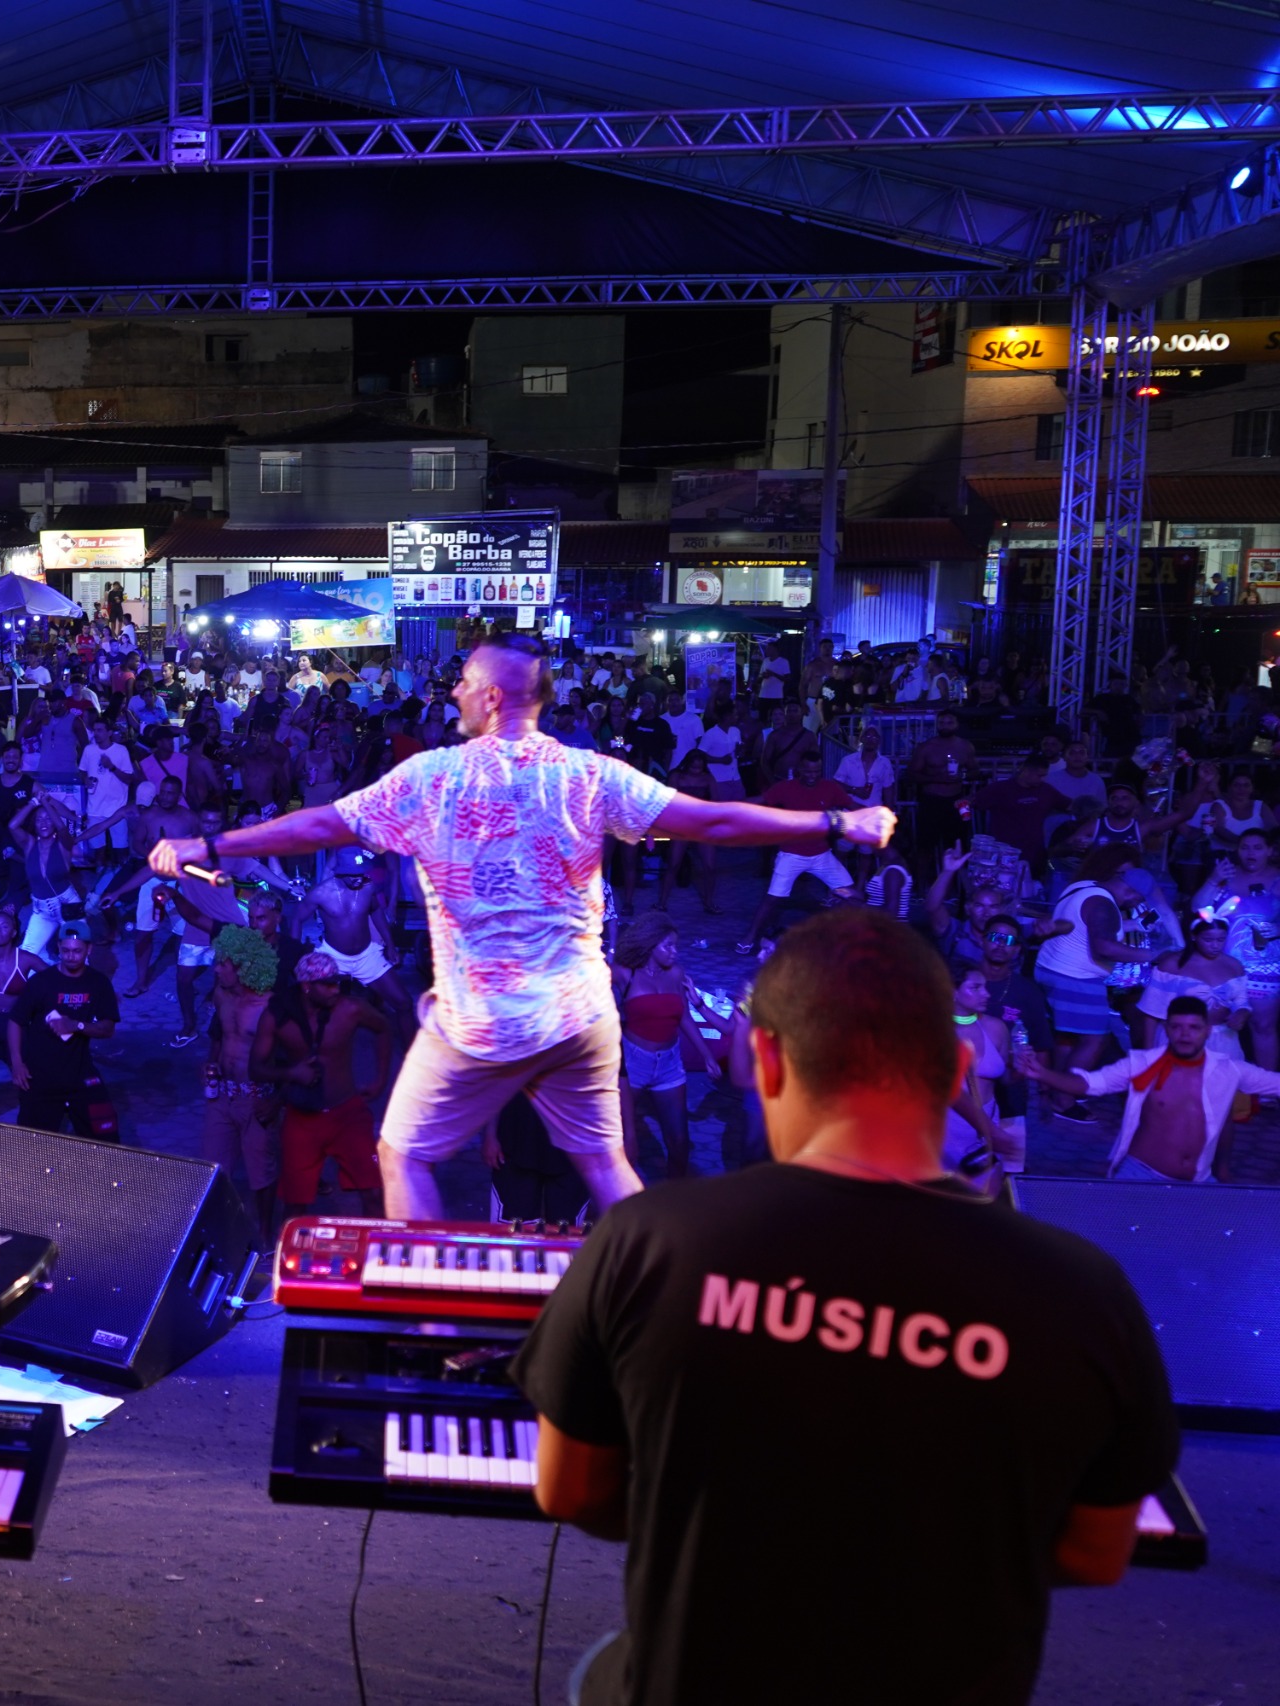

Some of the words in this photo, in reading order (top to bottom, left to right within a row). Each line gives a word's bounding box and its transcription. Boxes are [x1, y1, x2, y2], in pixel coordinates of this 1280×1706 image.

[983, 340, 1044, 361] SKOL
[1163, 329, 1231, 353] JOÃO
[78, 538, 96, 547] Dias
[415, 528, 480, 547] Copão
[483, 534, 495, 543] do
[448, 545, 512, 560] Barba
[699, 1273, 1009, 1380] MÚSICO
